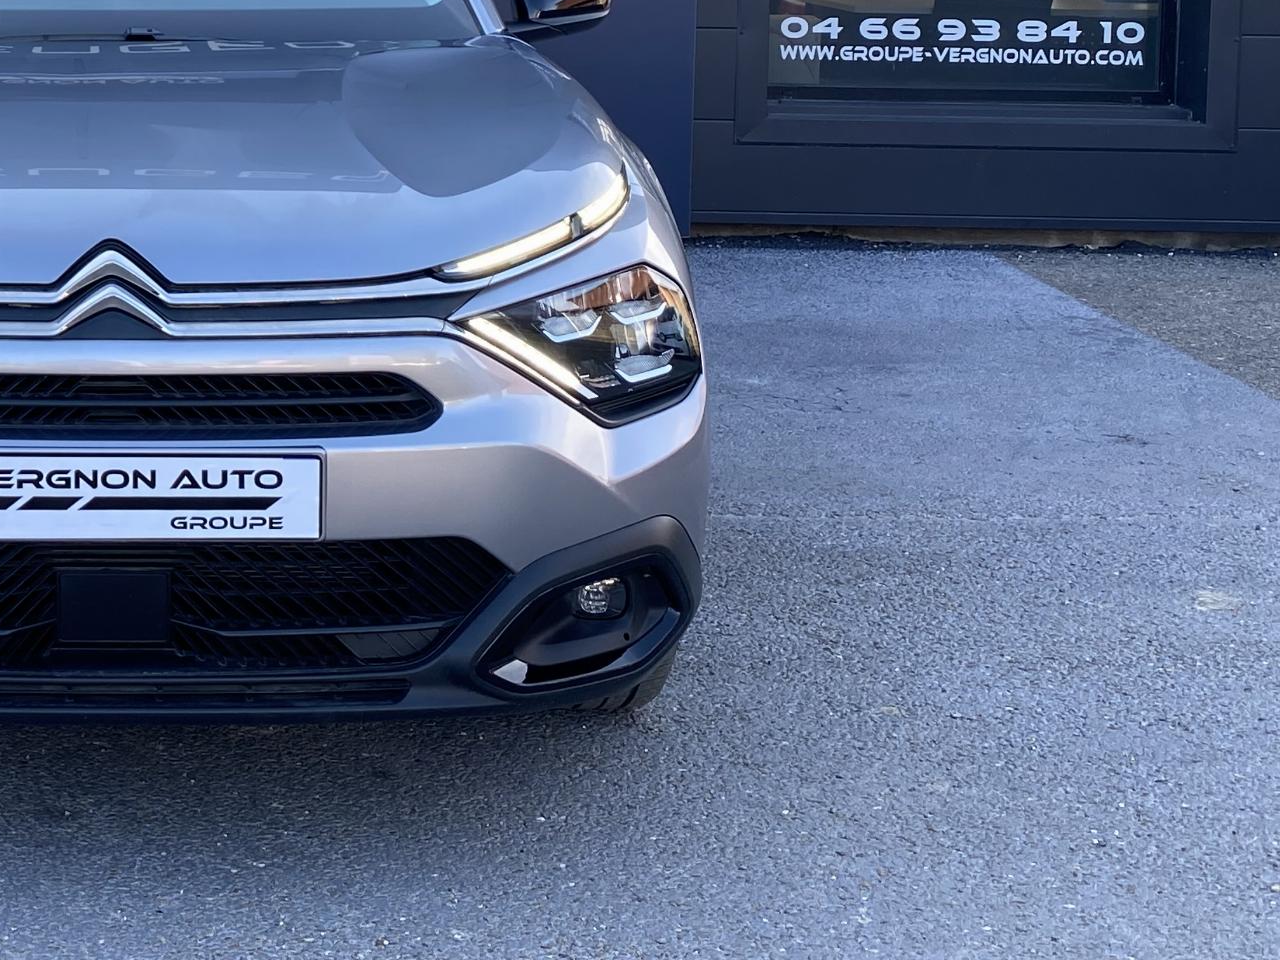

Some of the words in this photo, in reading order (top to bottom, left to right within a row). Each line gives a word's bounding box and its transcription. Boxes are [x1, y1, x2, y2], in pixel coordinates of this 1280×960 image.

[780, 17, 844, 39] 04
[859, 18, 921, 41] 66
[937, 19, 1001, 41] 93
[1017, 21, 1082, 43] 84
[1100, 21, 1145, 44] 10
[780, 45, 1144, 66] WWW.GROUPE-VERGNONAUTO.COM
[169, 469, 284, 490] AUTO
[170, 516, 284, 530] GROUPE
